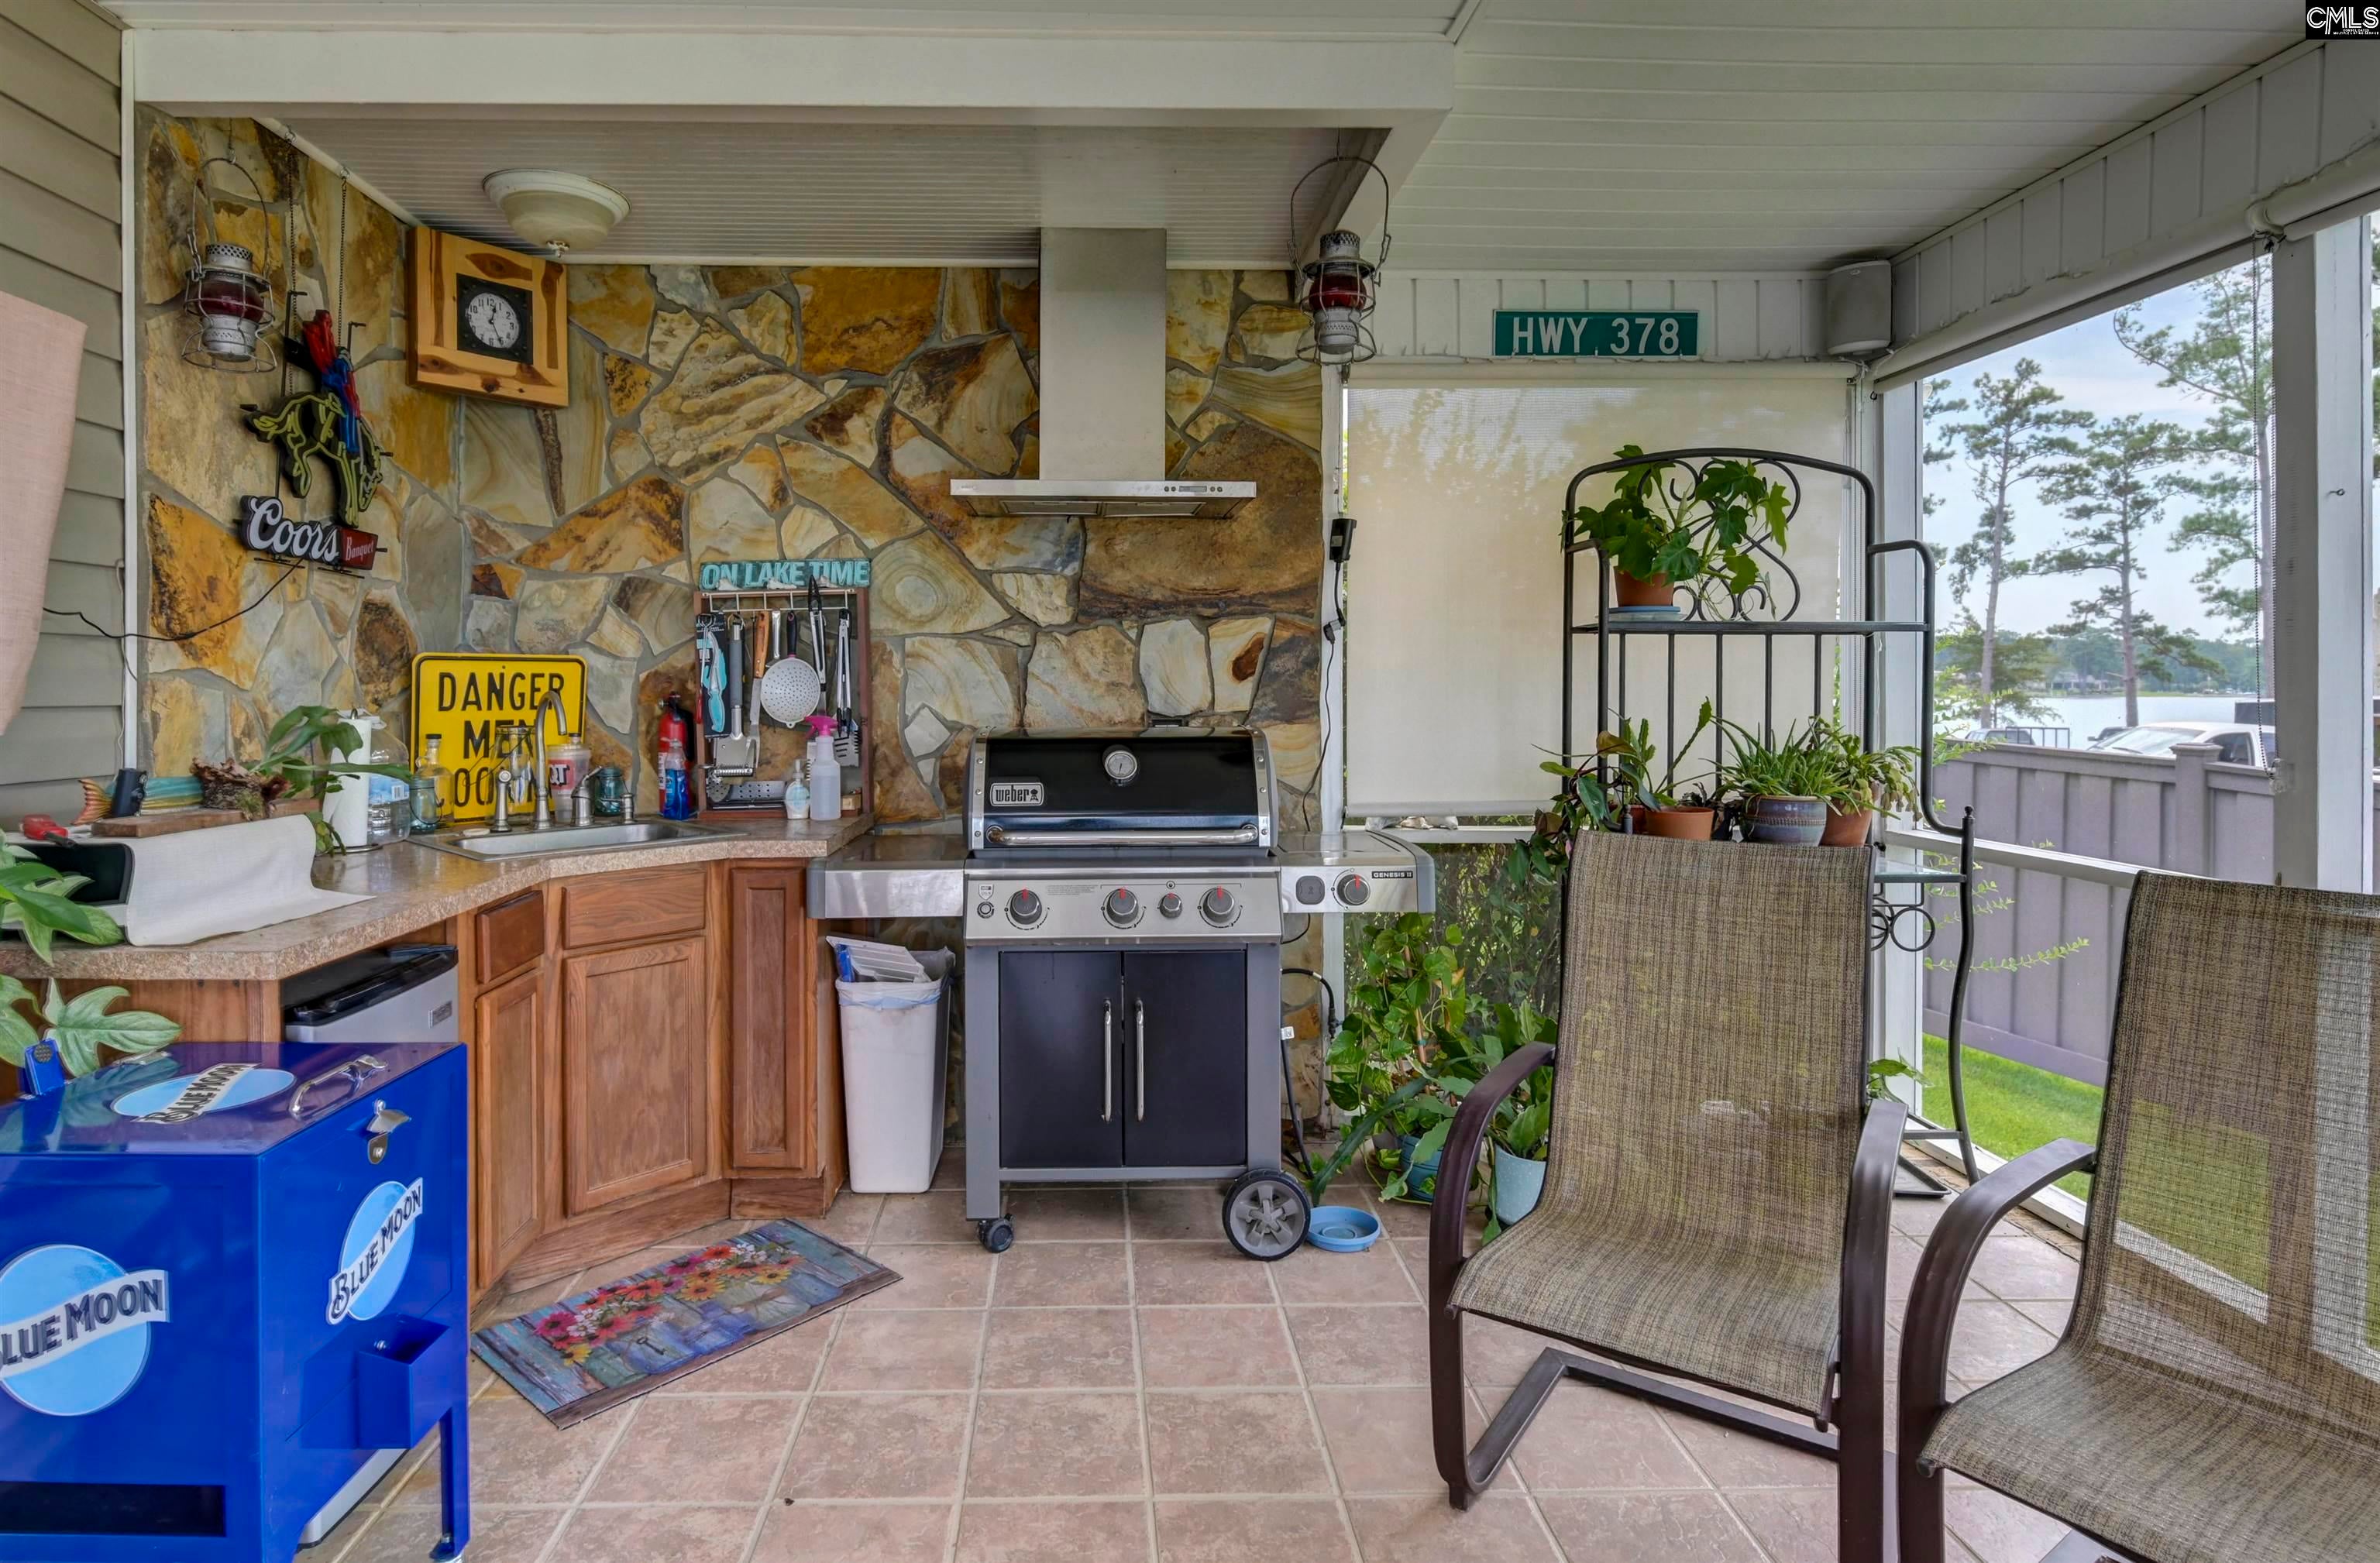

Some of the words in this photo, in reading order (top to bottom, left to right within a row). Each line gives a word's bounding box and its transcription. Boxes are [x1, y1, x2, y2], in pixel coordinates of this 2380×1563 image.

[1512, 317, 1588, 354] HWY
[1610, 318, 1680, 354] 378
[249, 497, 340, 562] Coors
[346, 536, 374, 562] Banquet
[702, 563, 738, 590] ON
[744, 562, 805, 589] LAKE
[810, 561, 870, 586] TIME
[438, 672, 565, 712] DANGER
[549, 764, 569, 786] QT
[996, 785, 1030, 802] weber
[331, 1241, 379, 1320] BLUE
[380, 1186, 421, 1255] MOON
[0, 1314, 62, 1366] LUE
[64, 1279, 165, 1341] MOON
